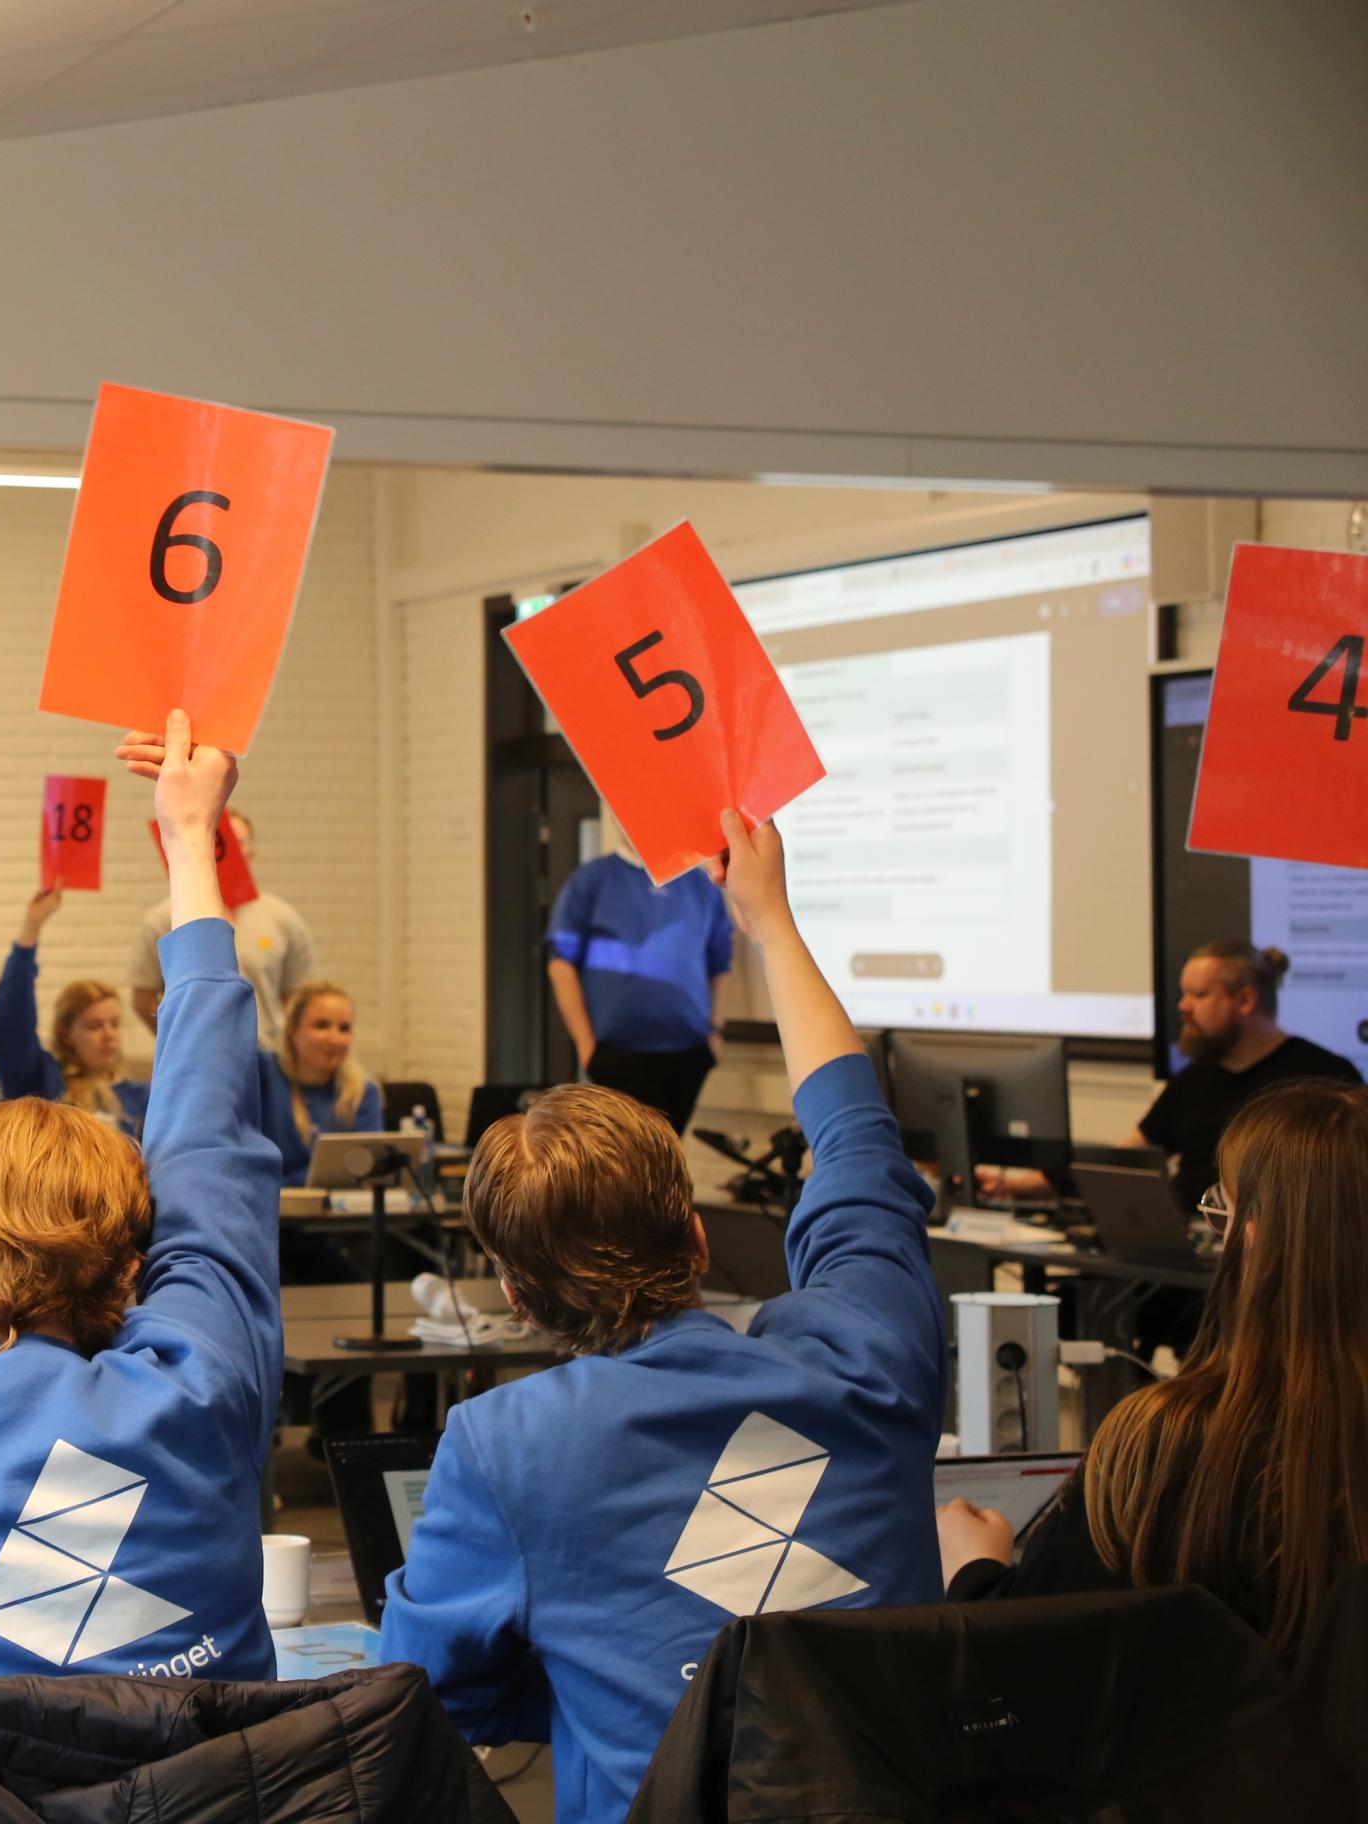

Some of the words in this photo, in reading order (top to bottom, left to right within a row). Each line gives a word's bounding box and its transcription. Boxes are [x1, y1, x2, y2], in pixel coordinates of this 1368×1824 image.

[150, 490, 231, 604] 6
[614, 630, 705, 741] 5
[1288, 635, 1368, 741] 4
[52, 803, 94, 842] 18
